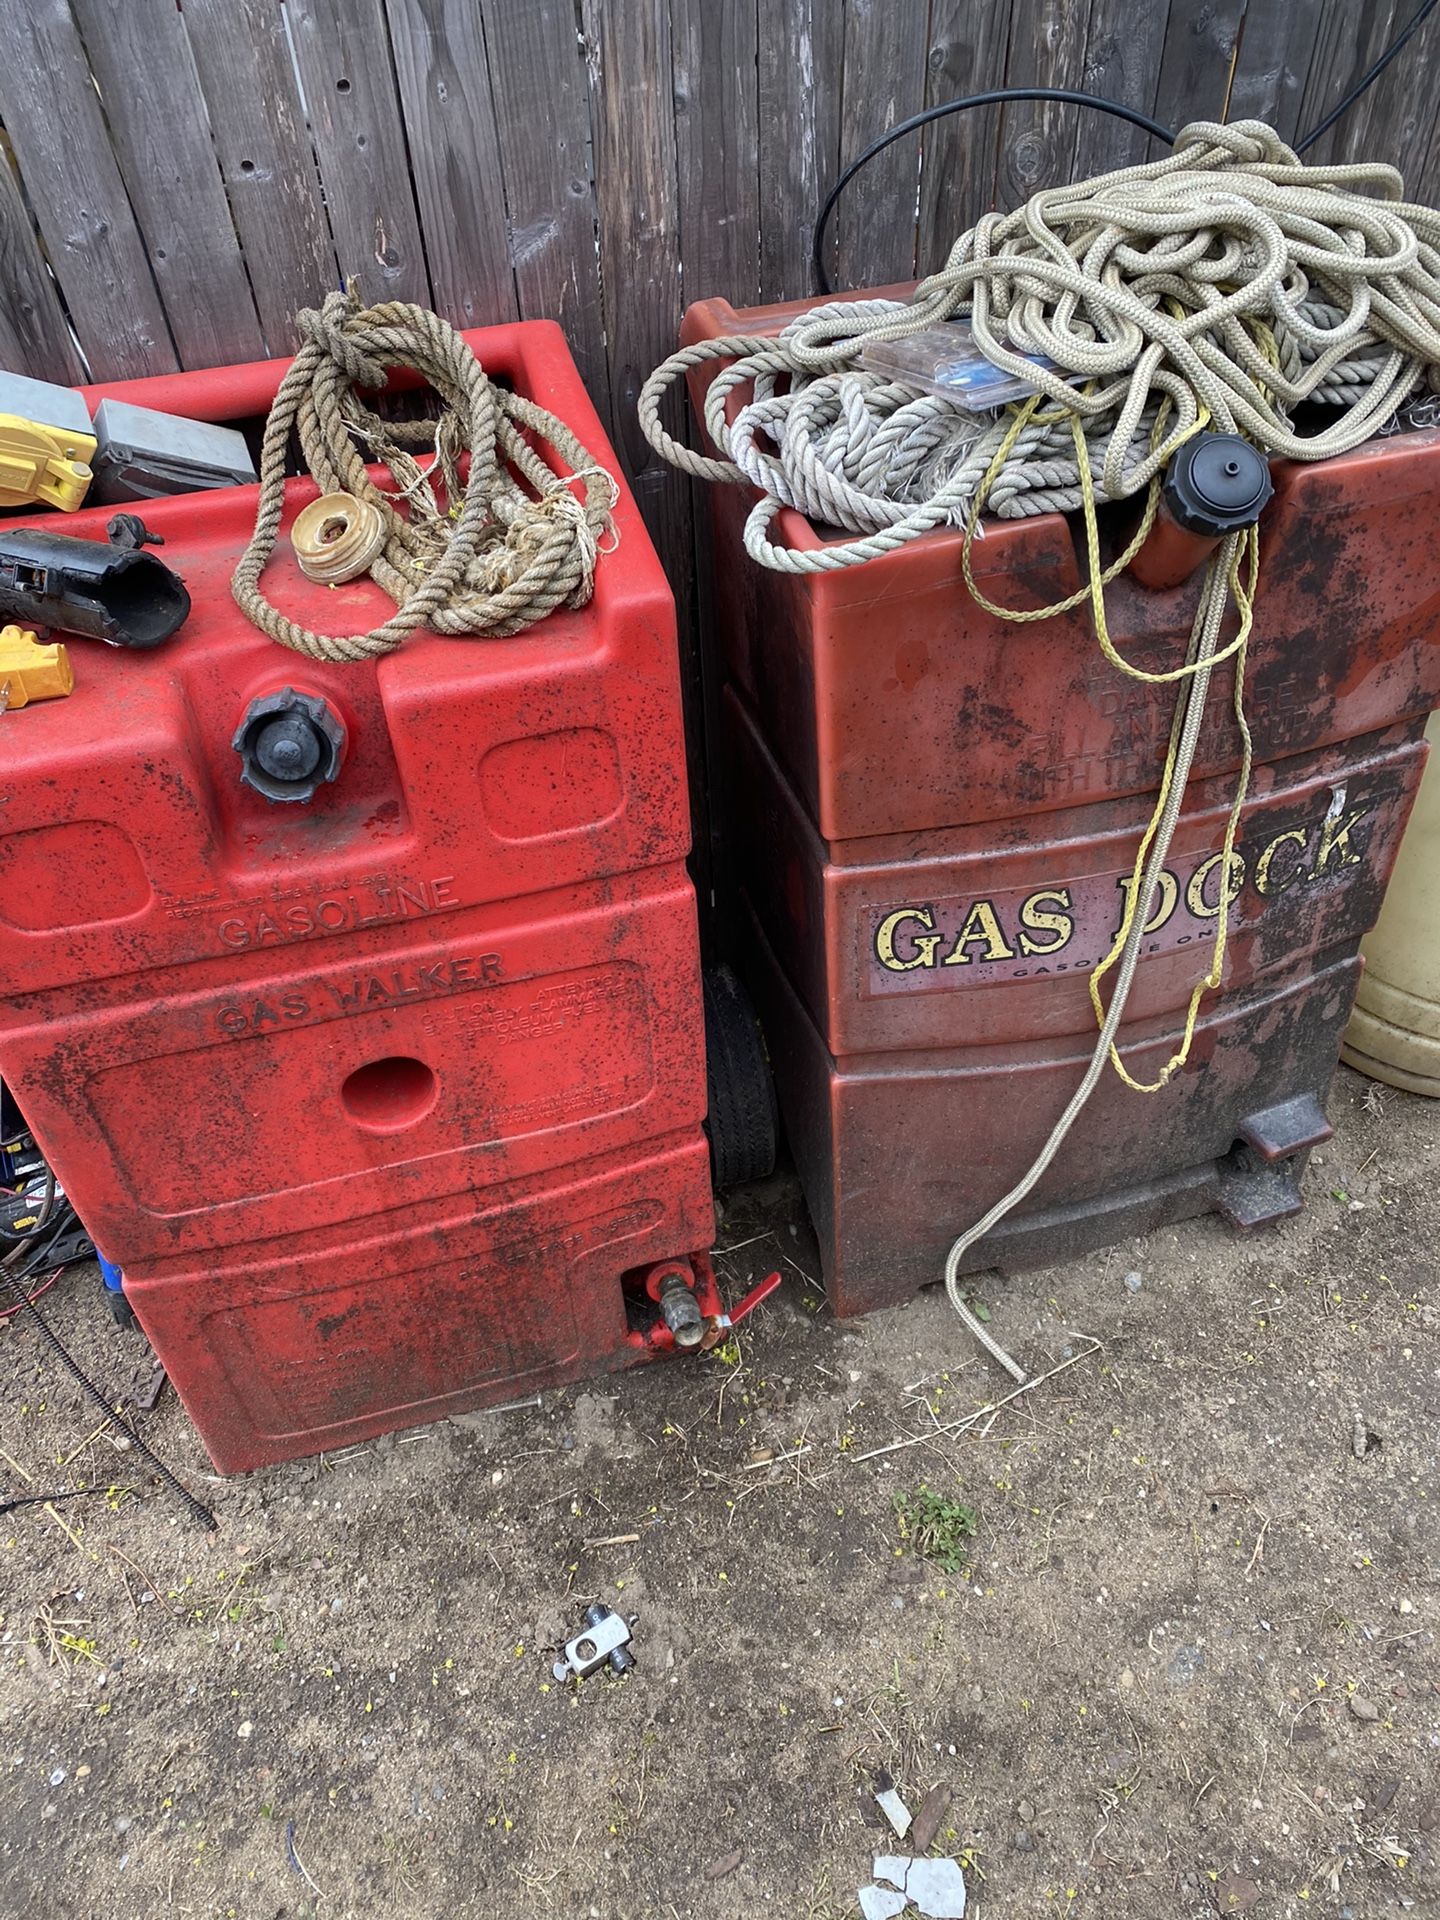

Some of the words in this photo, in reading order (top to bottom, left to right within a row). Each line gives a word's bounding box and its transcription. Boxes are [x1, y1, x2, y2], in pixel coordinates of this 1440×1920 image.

[218, 875, 460, 949] GASOLINE
[874, 888, 1074, 973] GAS
[1112, 805, 1366, 943] DOCK
[215, 993, 311, 1034] GAS
[327, 952, 507, 1010] WALKER
[454, 1011, 554, 1041] PETROLEUM
[561, 1001, 601, 1018] FUEL
[497, 1020, 564, 1045] DANGER
